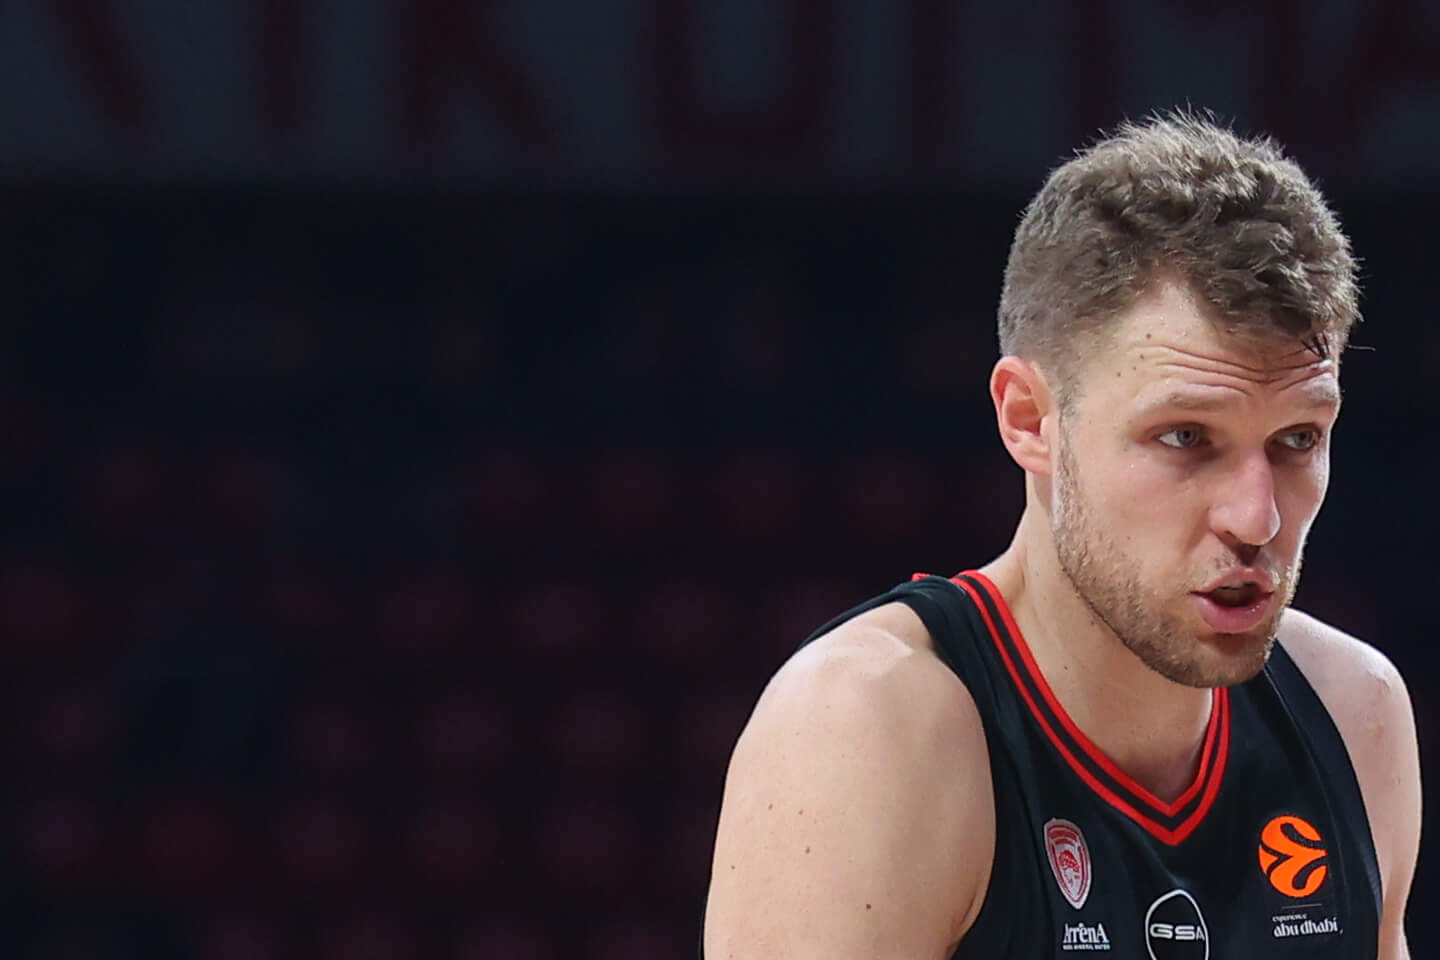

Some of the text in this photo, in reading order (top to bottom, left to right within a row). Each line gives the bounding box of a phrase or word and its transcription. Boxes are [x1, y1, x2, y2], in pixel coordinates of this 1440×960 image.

[1150, 922, 1205, 941] GSA
[1273, 916, 1338, 938] abu dhabi
